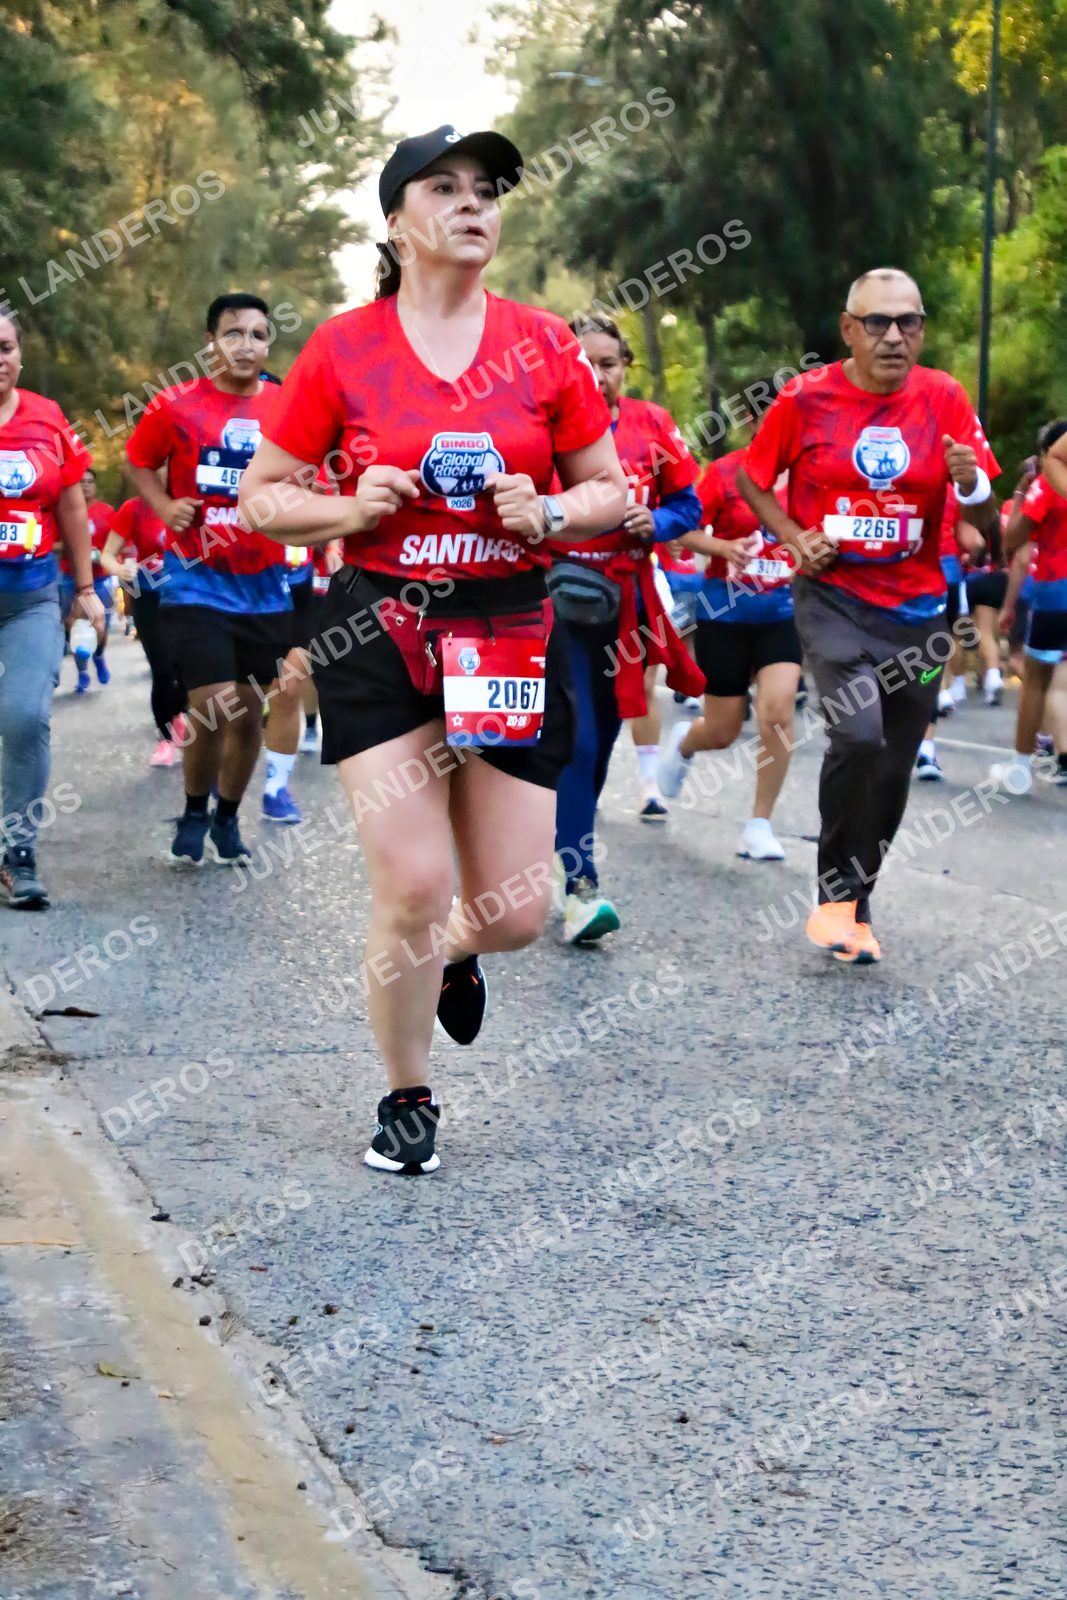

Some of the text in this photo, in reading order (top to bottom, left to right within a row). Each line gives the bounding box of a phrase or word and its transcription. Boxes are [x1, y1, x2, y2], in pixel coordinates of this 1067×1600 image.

[440, 440, 485, 448] BIMBO
[442, 453, 486, 467] Global
[433, 465, 468, 477] Race
[450, 499, 472, 509] 2026
[852, 518, 896, 538] 2265
[487, 679, 539, 710] 2067
